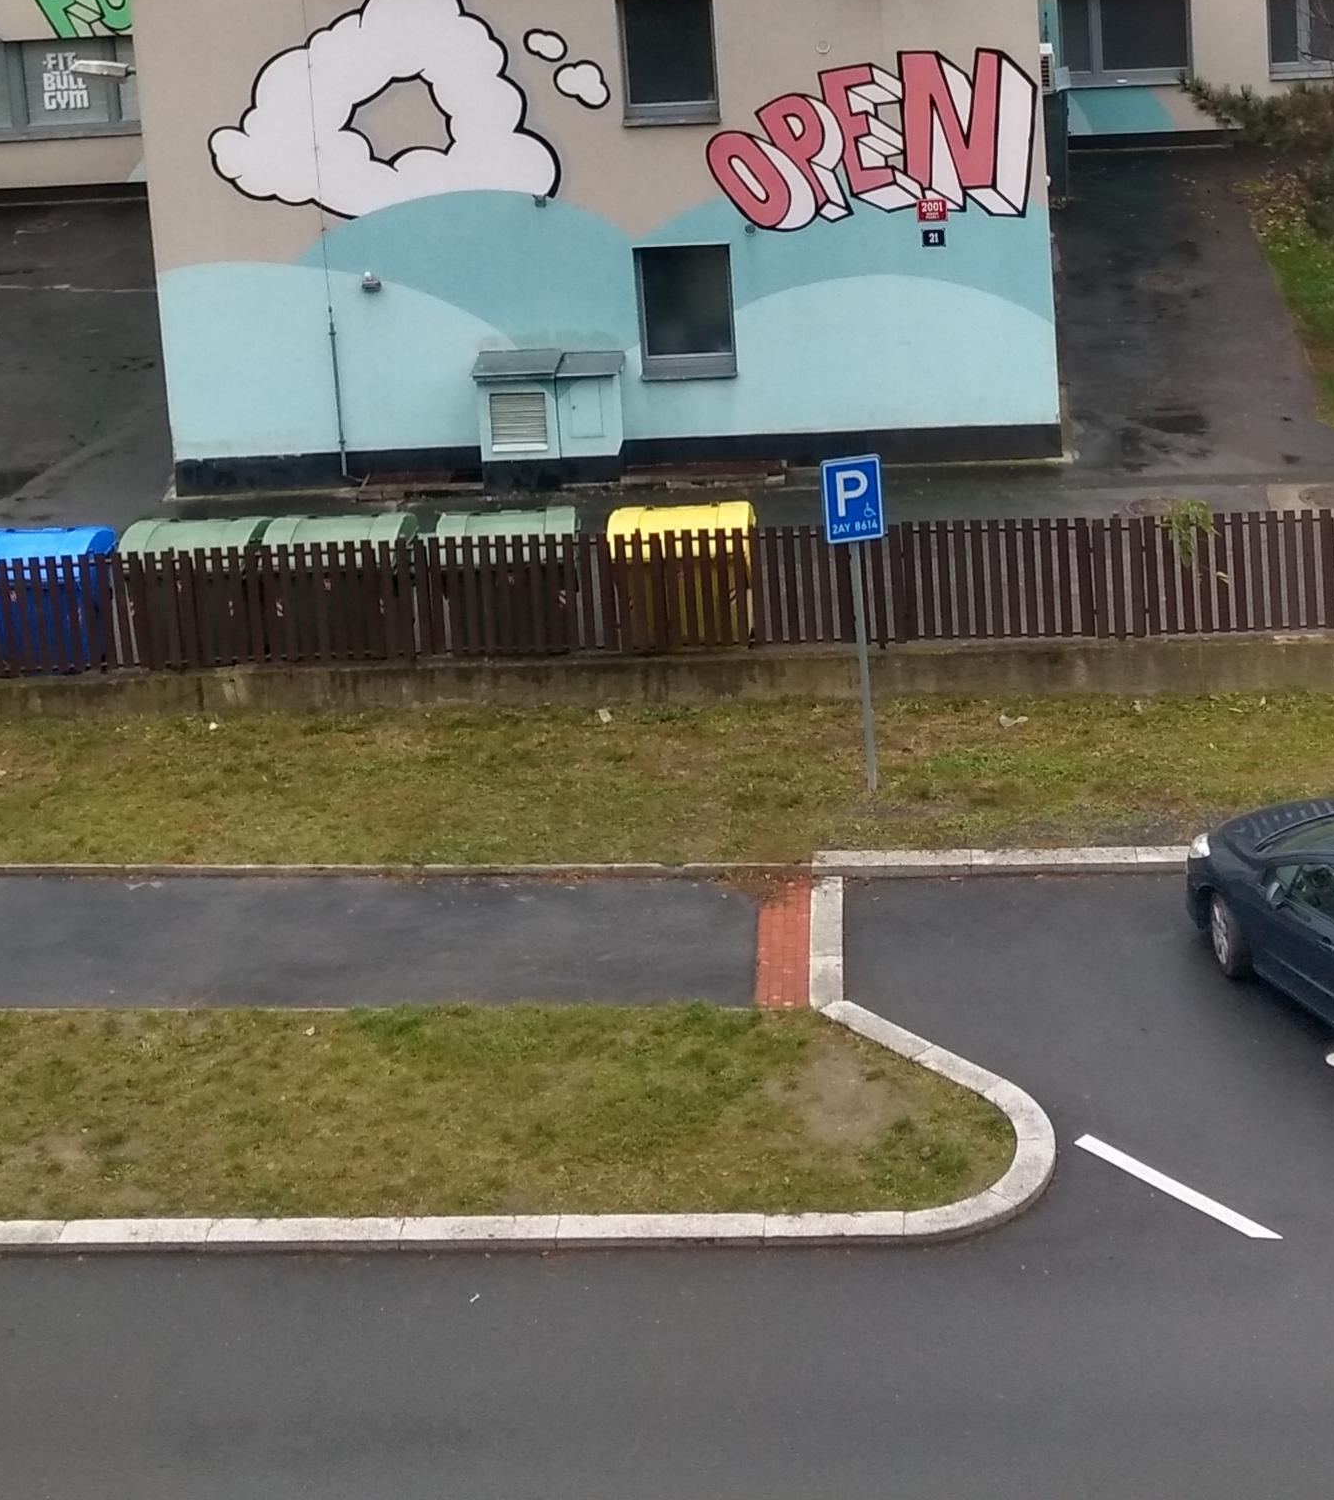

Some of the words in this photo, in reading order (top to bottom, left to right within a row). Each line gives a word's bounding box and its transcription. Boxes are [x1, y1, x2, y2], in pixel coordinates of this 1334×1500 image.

[43, 71, 87, 91] BULL
[43, 90, 90, 110] GYM
[706, 47, 1037, 232] OPEN
[921, 201, 944, 212] 2001
[928, 232, 939, 243] 21
[835, 469, 868, 517] P
[832, 521, 851, 535] 2AY
[854, 518, 878, 531] 8614
